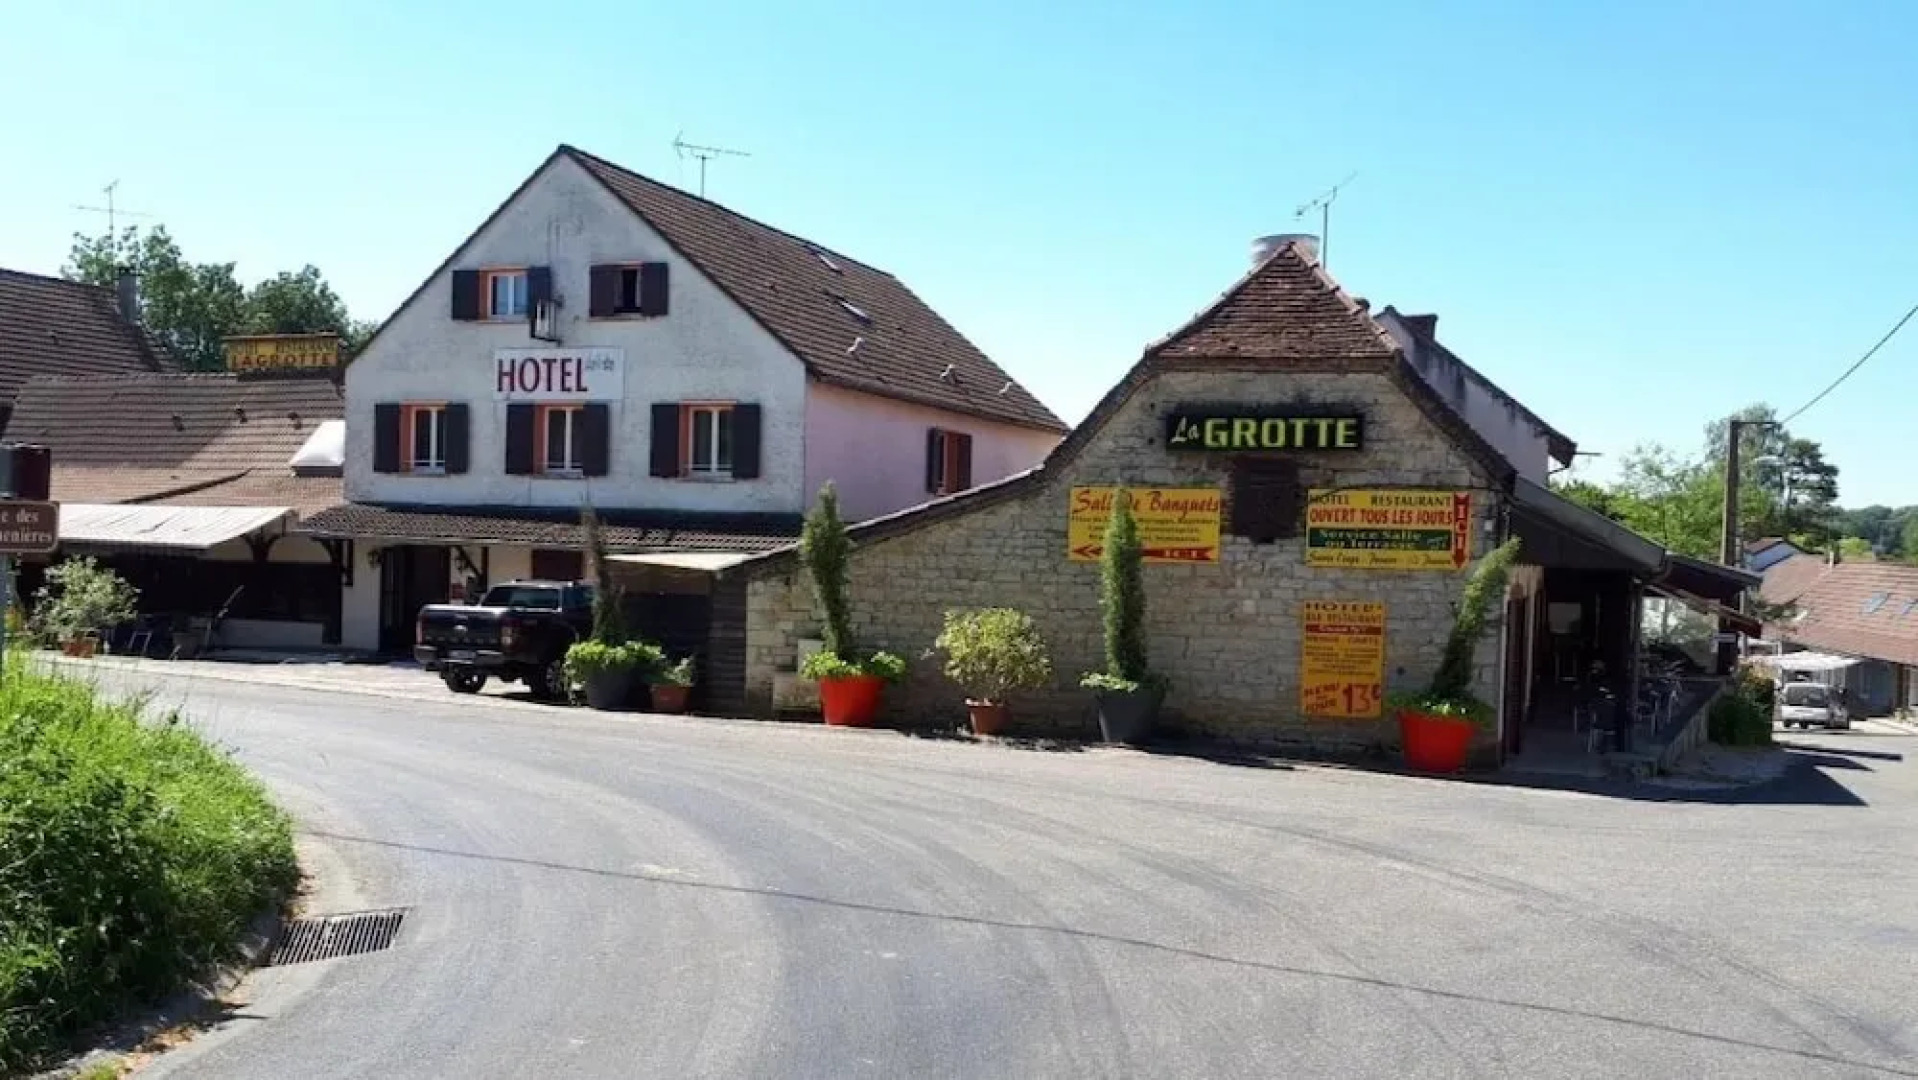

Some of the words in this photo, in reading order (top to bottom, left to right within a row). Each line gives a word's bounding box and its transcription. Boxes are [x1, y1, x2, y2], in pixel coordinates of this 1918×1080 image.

[497, 357, 589, 392] HOTEL
[1170, 416, 1200, 443] La
[1204, 417, 1358, 447] GROTTE
[1370, 496, 1452, 507] RESTAURANT
[17, 508, 39, 522] des
[1310, 507, 1355, 523] OUVERT
[1361, 508, 1389, 524] TOUS
[1392, 508, 1414, 524] LES
[1416, 509, 1453, 525] JOURS
